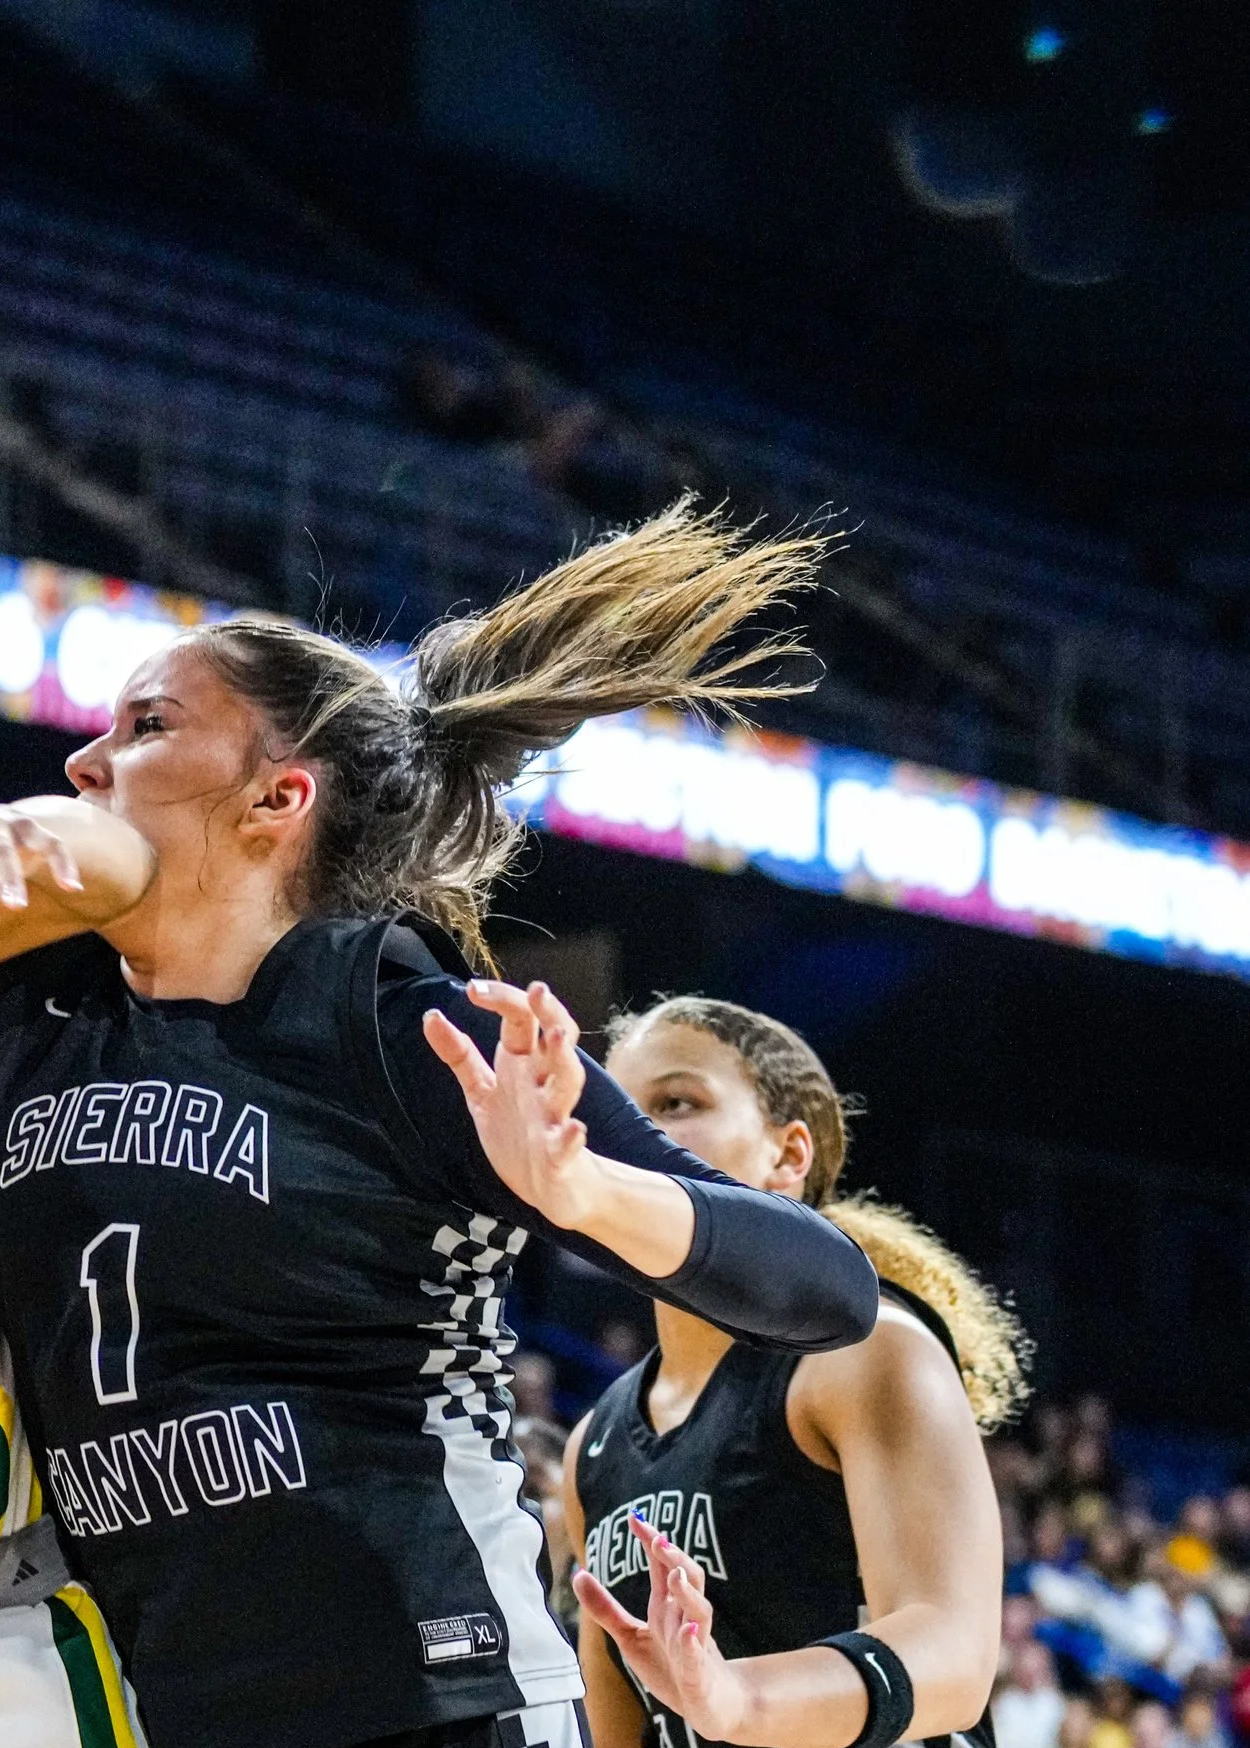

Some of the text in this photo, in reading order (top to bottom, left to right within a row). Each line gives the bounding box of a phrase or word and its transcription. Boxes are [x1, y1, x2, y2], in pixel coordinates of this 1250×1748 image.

[0, 1080, 270, 1205] SIERRA
[79, 1222, 141, 1406] 1
[473, 1624, 496, 1645] XL
